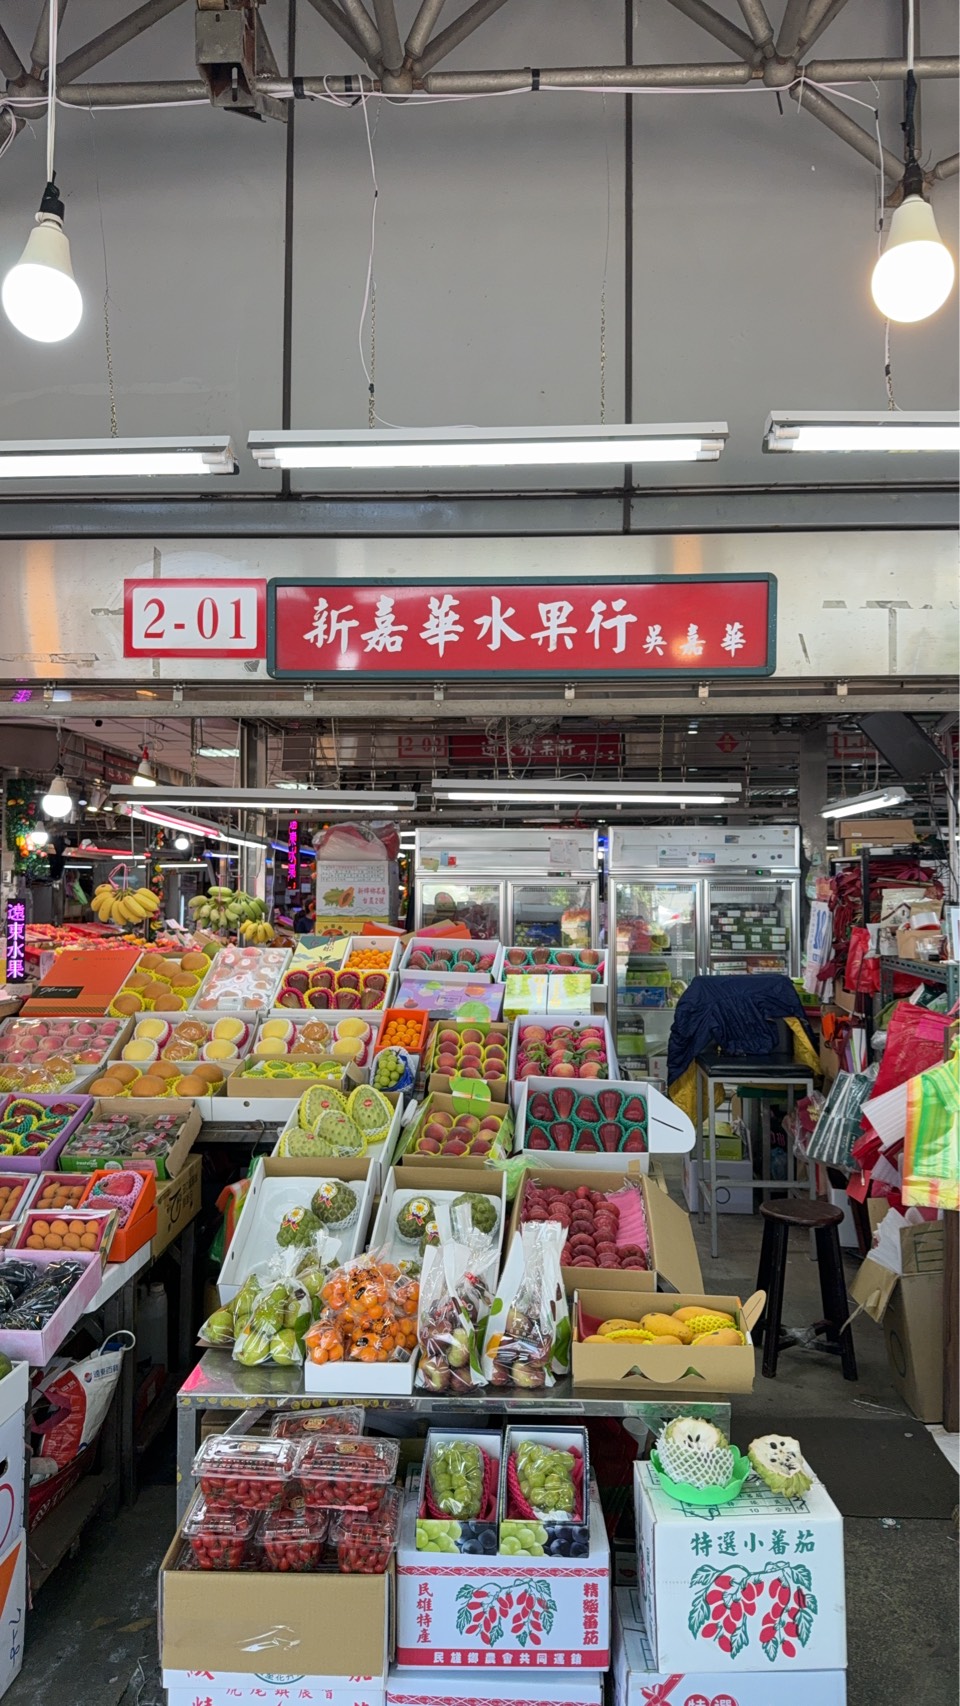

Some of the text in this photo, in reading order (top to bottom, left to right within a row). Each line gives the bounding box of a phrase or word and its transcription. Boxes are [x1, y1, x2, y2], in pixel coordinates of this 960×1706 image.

[142, 596, 247, 641] 2-01
[303, 593, 746, 658] 新嘉華水果行 吳嘉華
[7, 903, 25, 978] 遠東水果
[690, 1529, 816, 1557] 特選小蕃茄
[416, 1583, 434, 1643] 民雄特產
[433, 1651, 582, 1665] 民雄鄉農會共同運銷
